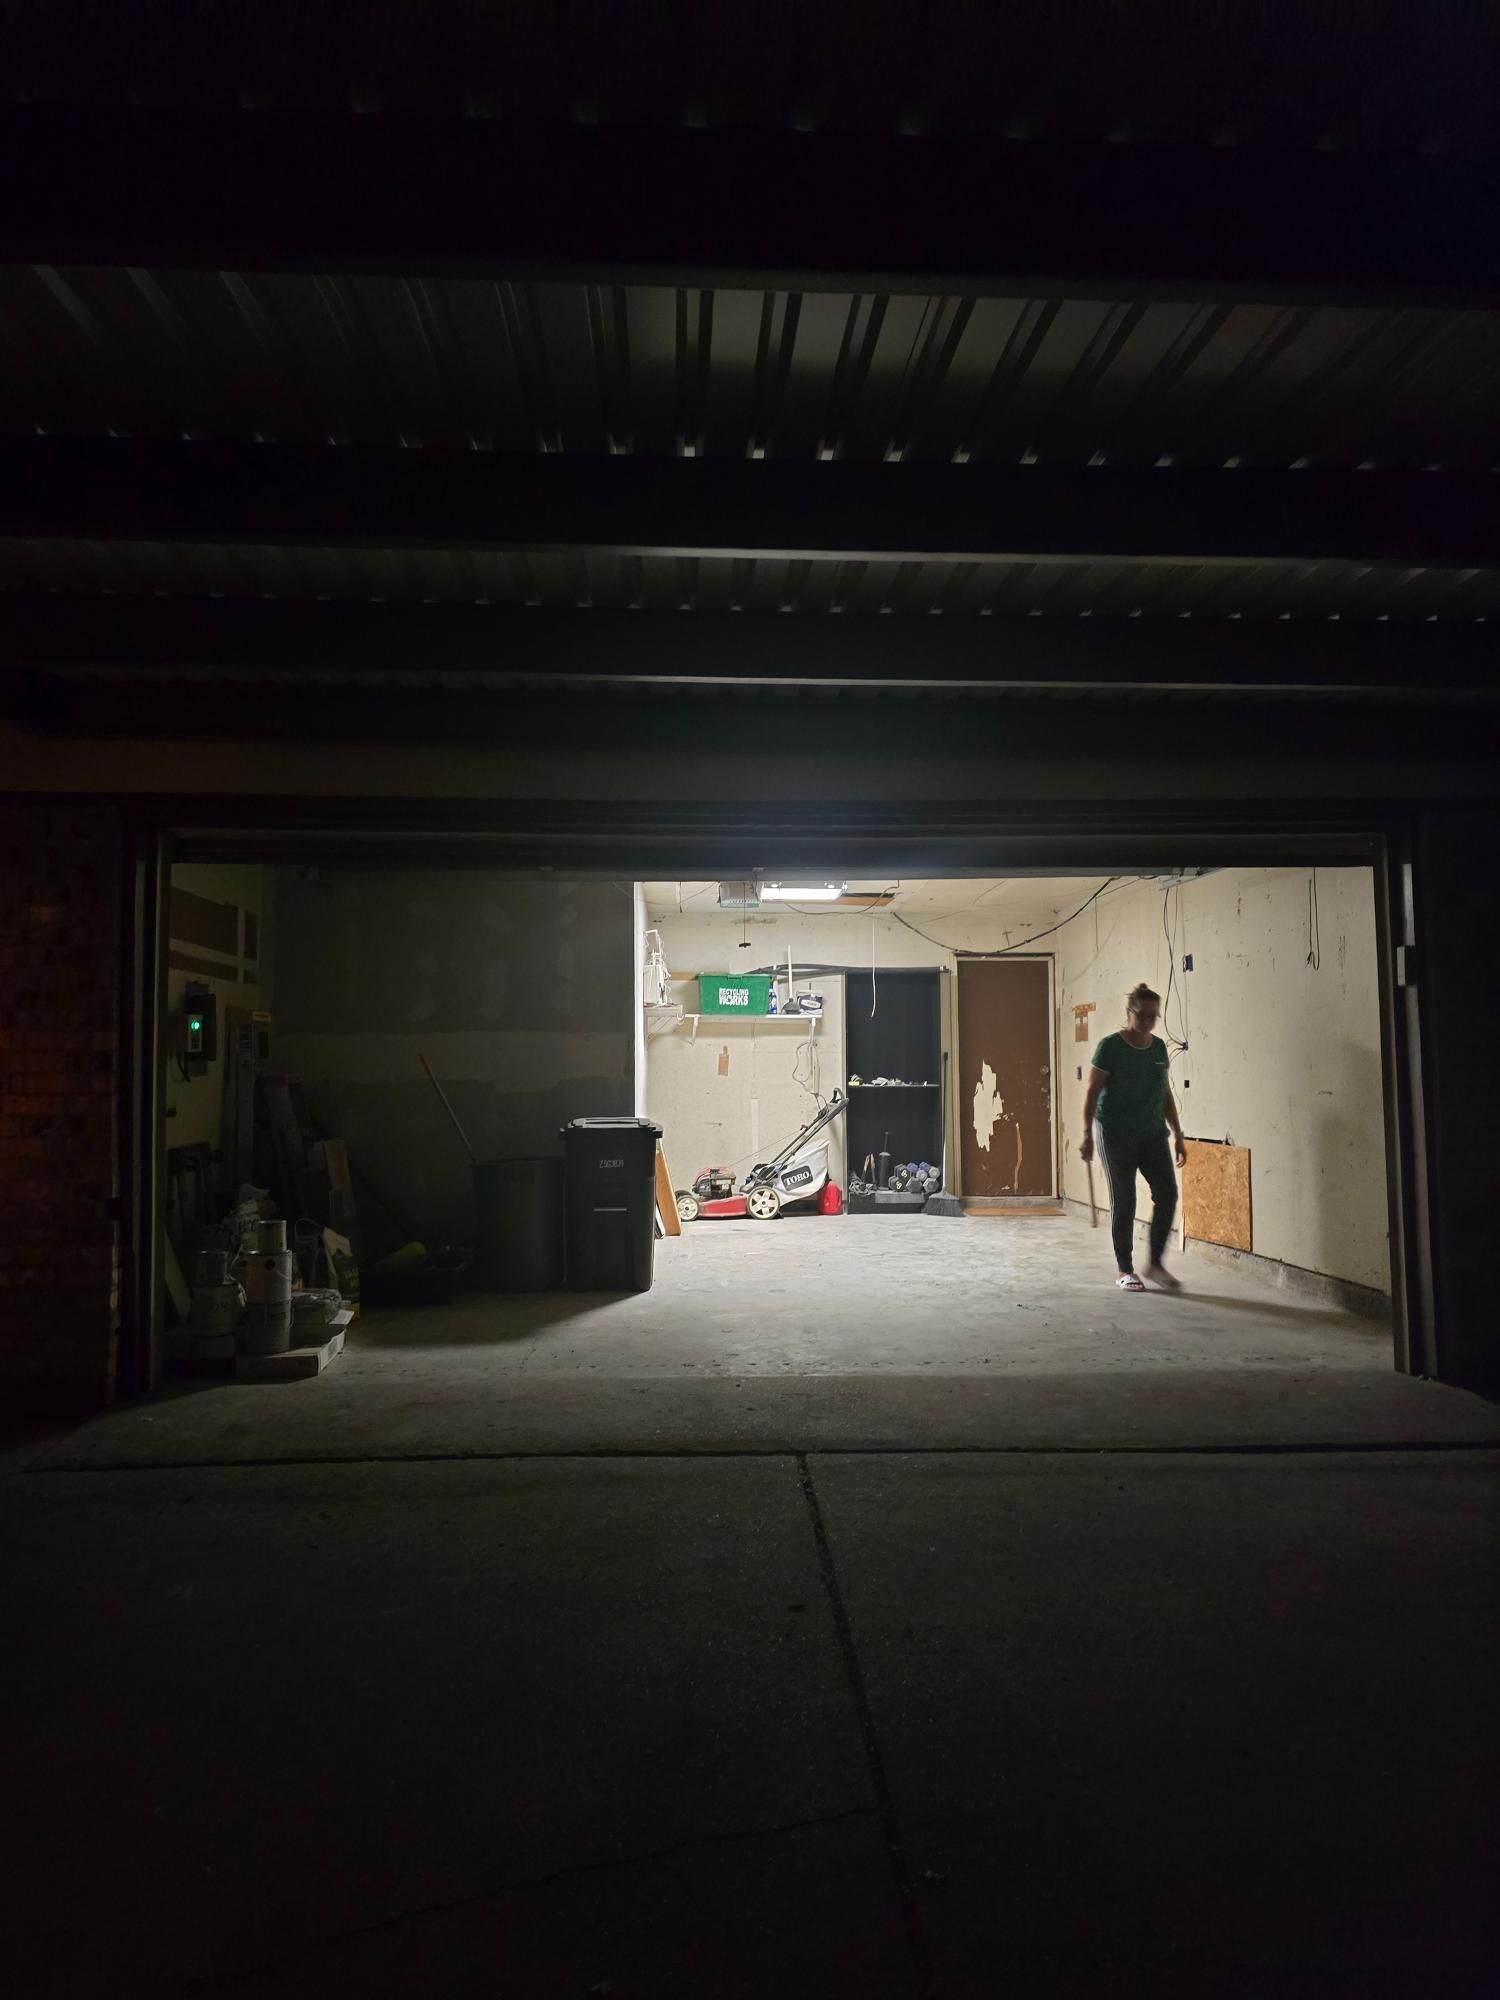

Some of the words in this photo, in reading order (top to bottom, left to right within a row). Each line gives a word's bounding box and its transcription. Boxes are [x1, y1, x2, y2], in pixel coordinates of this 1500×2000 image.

[719, 987, 749, 996] RECYCLING
[719, 994, 749, 1006] WORKS
[783, 1171, 810, 1186] TORO
